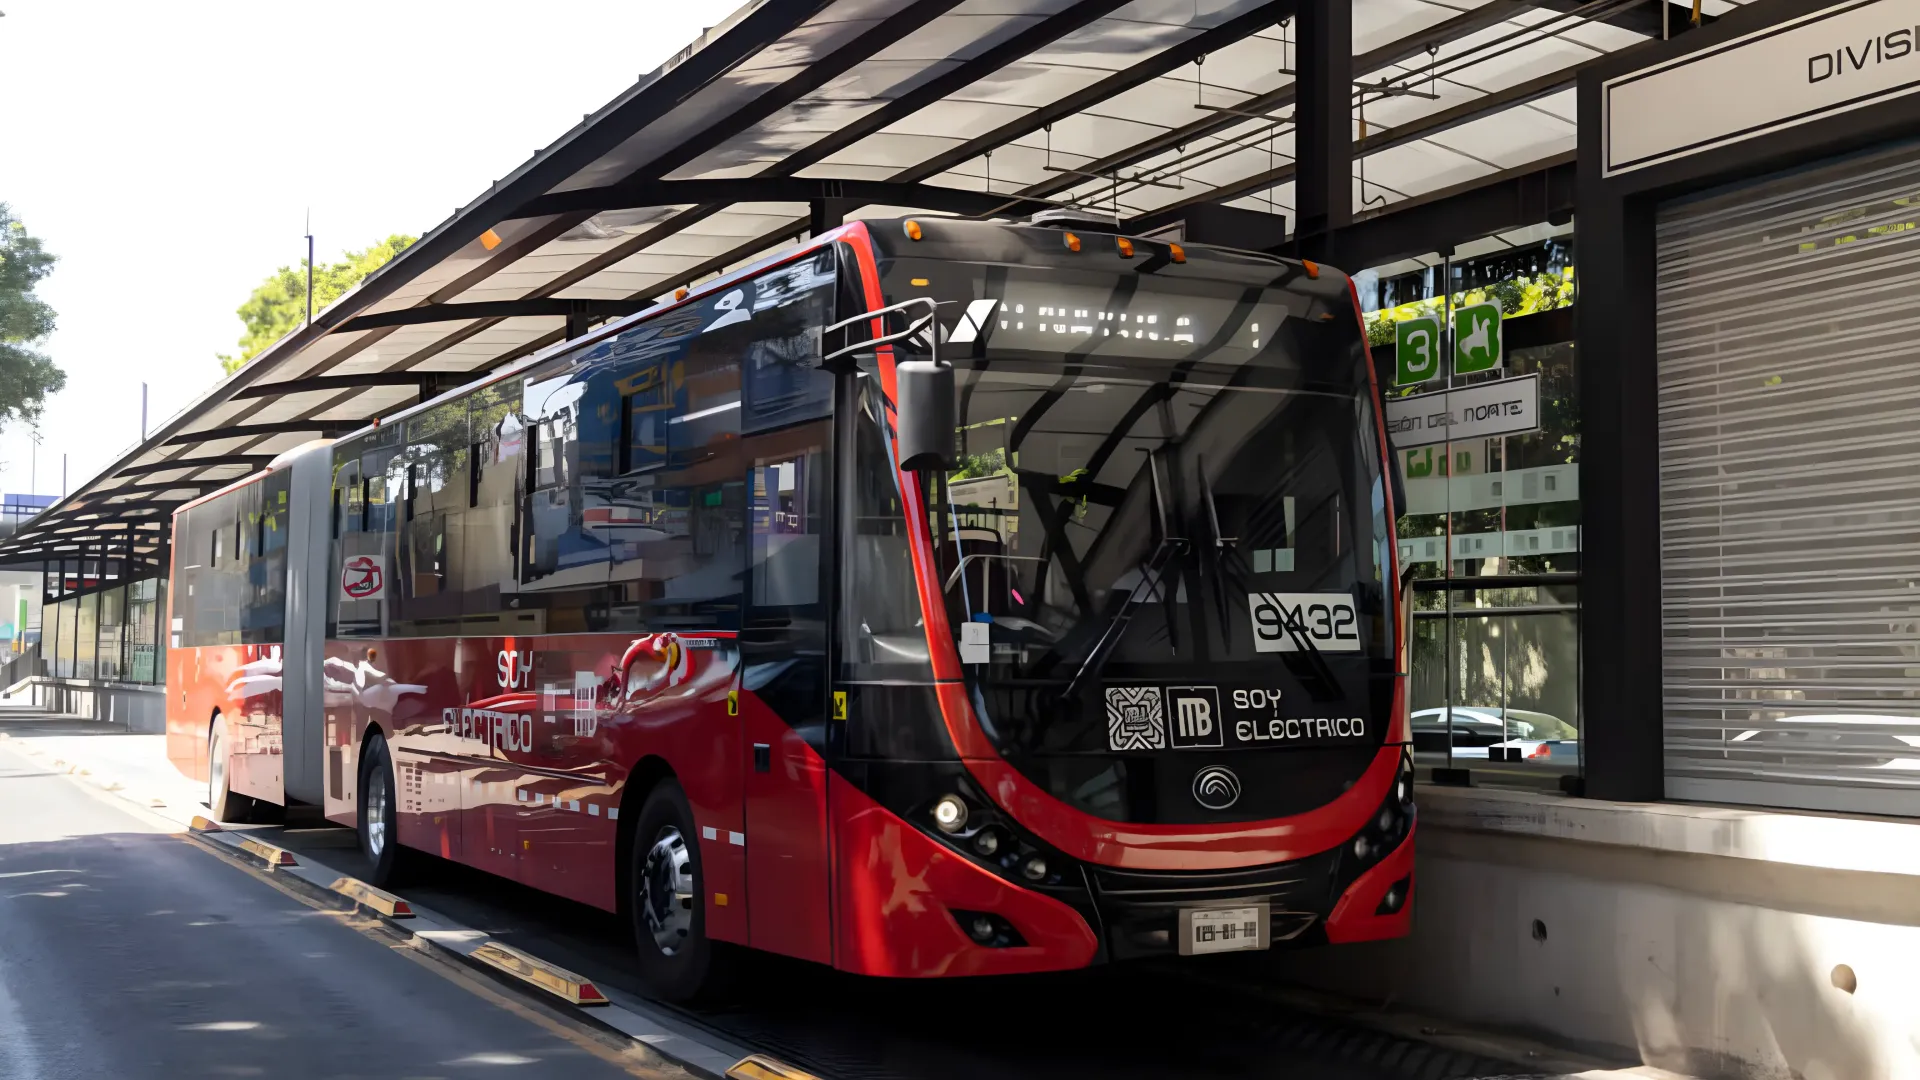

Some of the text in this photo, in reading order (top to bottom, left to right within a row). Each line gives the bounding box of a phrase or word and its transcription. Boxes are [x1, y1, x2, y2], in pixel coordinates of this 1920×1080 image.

[1406, 329, 1430, 373] 3
[1254, 603, 1358, 641] 9432
[497, 650, 534, 689] SOY
[1232, 688, 1282, 709] SOY
